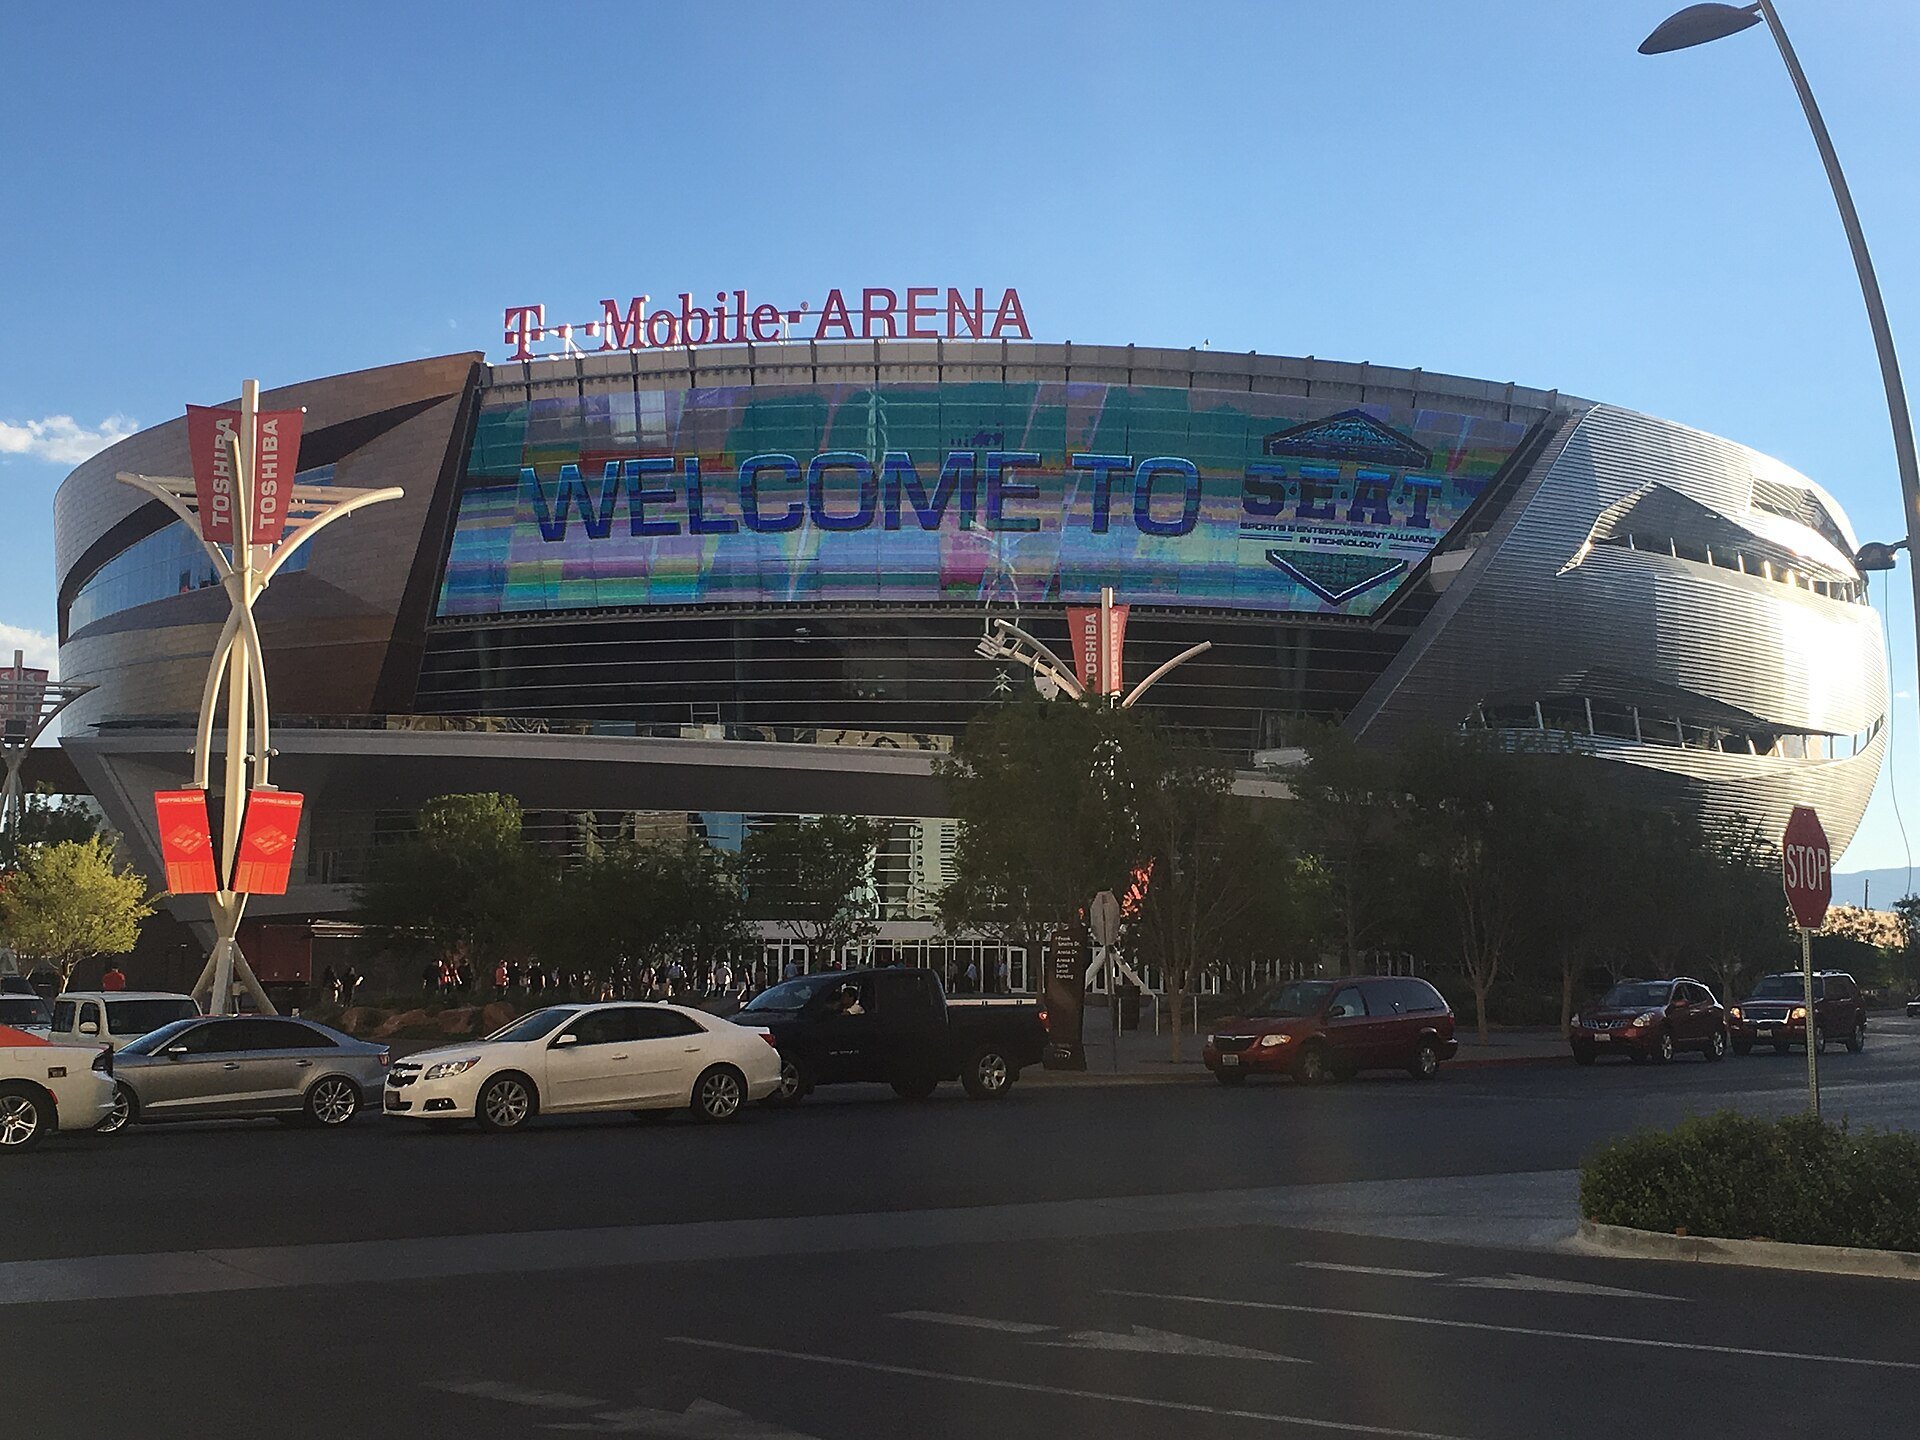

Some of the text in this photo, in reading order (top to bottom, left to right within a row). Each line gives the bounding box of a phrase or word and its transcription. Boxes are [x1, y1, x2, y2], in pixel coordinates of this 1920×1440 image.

[814, 287, 1033, 341] ARENA
[259, 418, 279, 529] TOSHIBA
[519, 451, 1199, 543] WELCOME TO
[1240, 522, 1286, 533] SPORTS
[1296, 525, 1387, 541] ENTERTAINMENT
[1388, 532, 1437, 545] ALLIANCE
[1299, 536, 1382, 550] IN TECHNOLOGY
[1786, 843, 1828, 891] STOP
